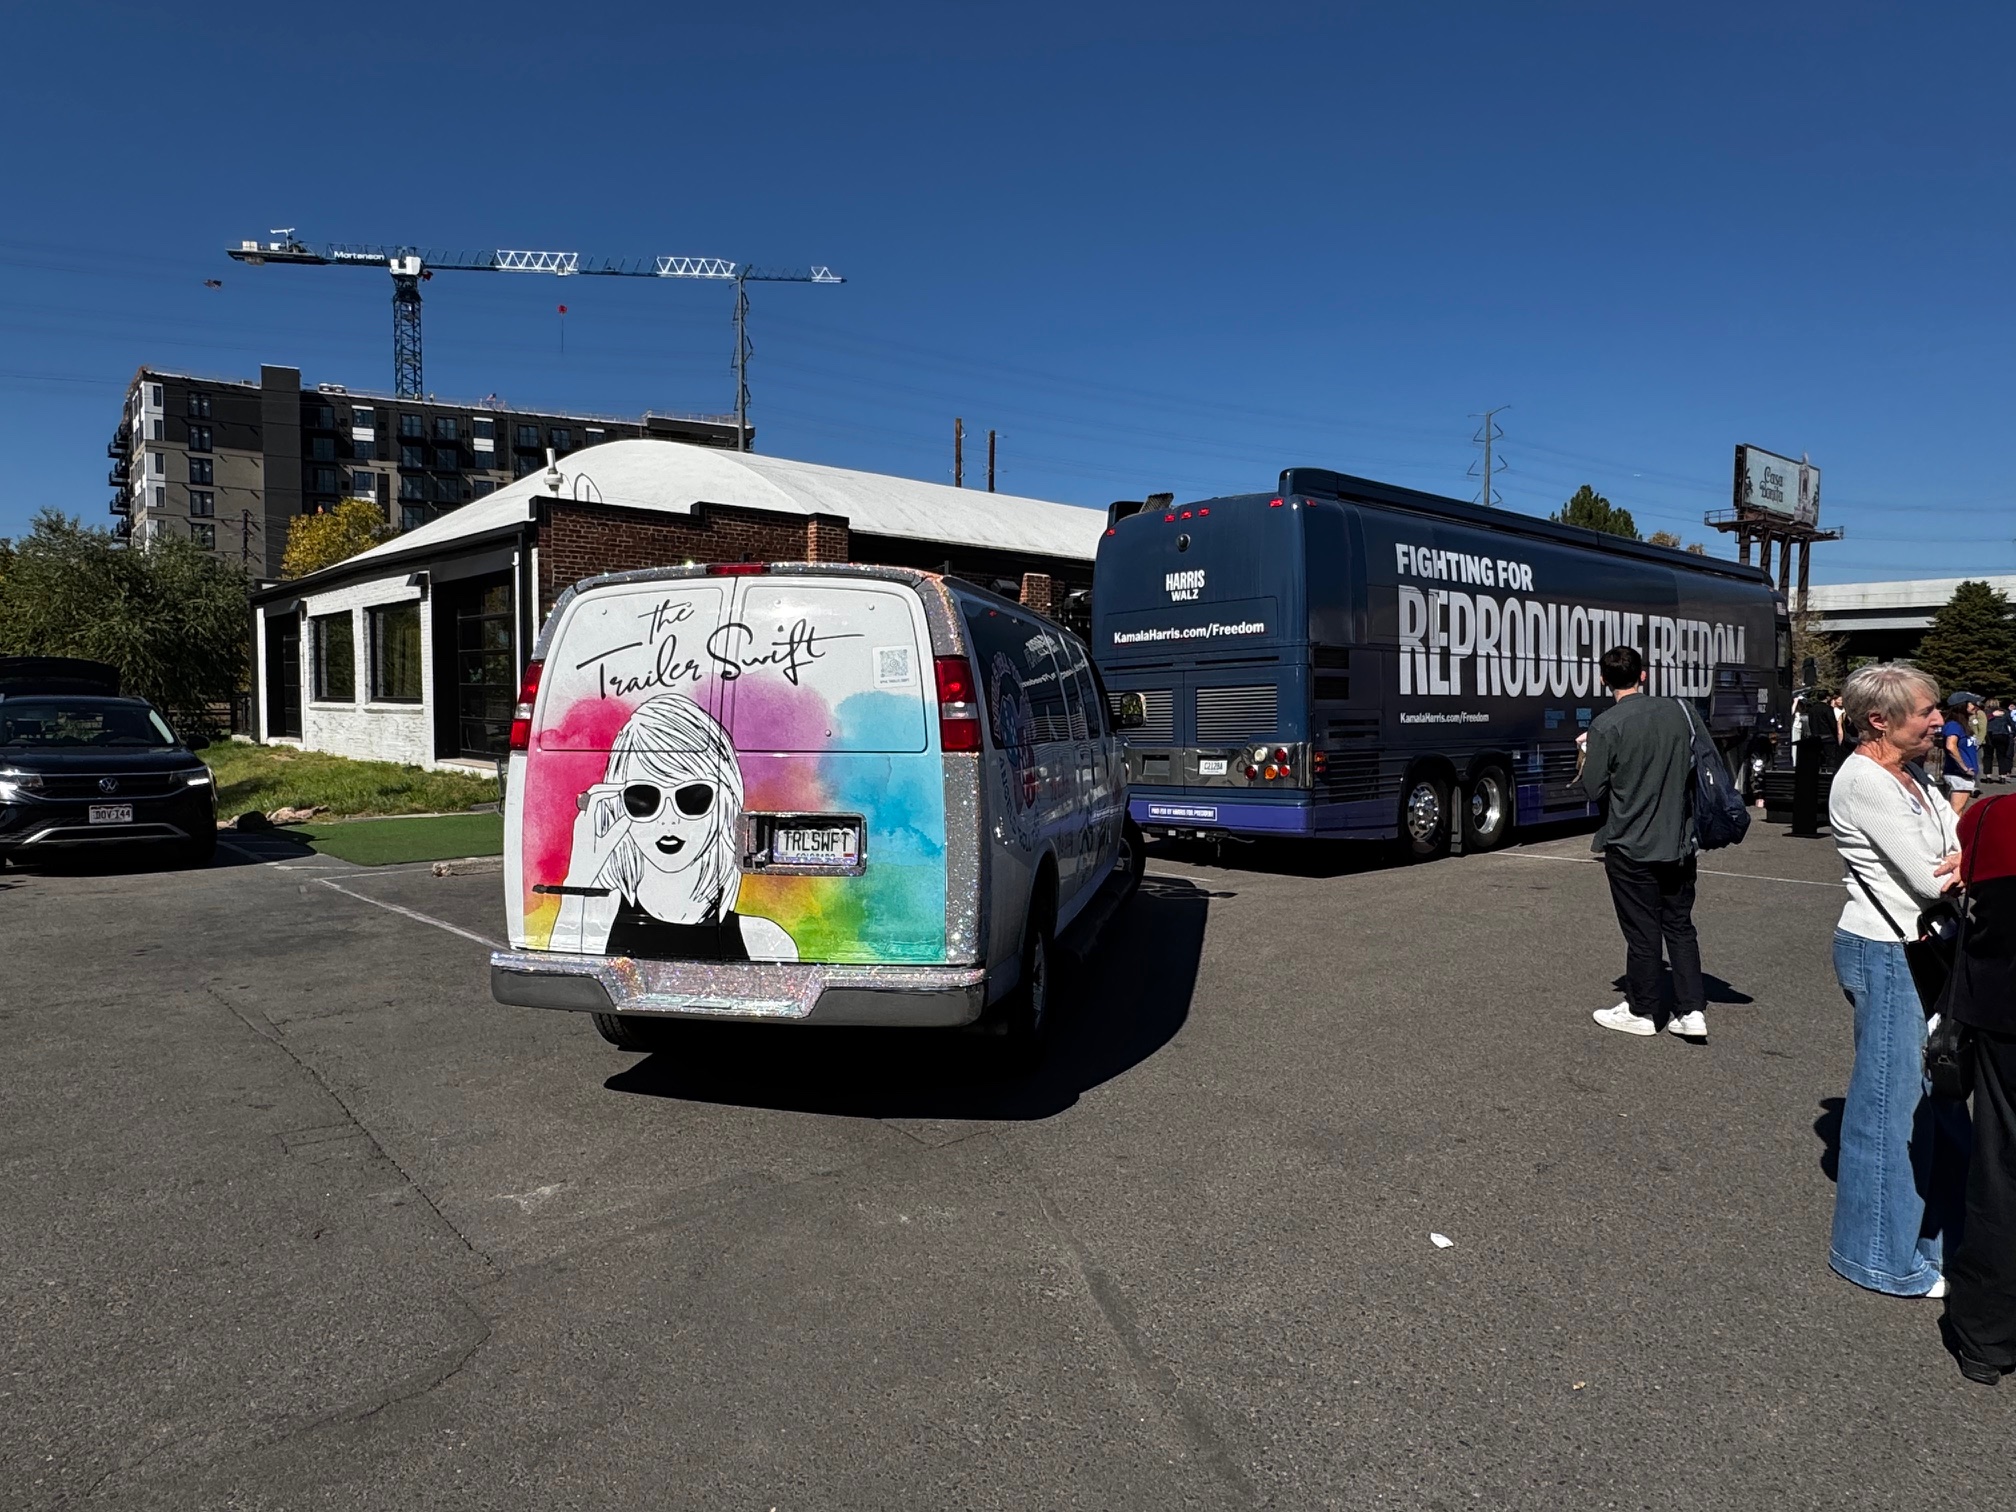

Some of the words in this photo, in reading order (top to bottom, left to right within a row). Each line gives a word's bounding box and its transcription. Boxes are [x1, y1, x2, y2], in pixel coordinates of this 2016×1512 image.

[333, 250, 385, 261] Mortenson
[1764, 466, 1784, 487] Casa
[1759, 480, 1784, 503] Bonita
[1395, 543, 1494, 587] FIGHTING
[1497, 559, 1534, 592] FOR
[1165, 569, 1205, 591] HARRIS
[1171, 589, 1199, 602] WALZ
[1113, 621, 1265, 644] KamalaHarris.com/Freedom
[576, 635, 702, 700] Trailer
[706, 618, 865, 686] Swift
[1648, 614, 1746, 698] FREEDOM
[1400, 711, 1490, 725] KamalaHarris.com/Freedom
[784, 830, 850, 852] TRLSWFT
